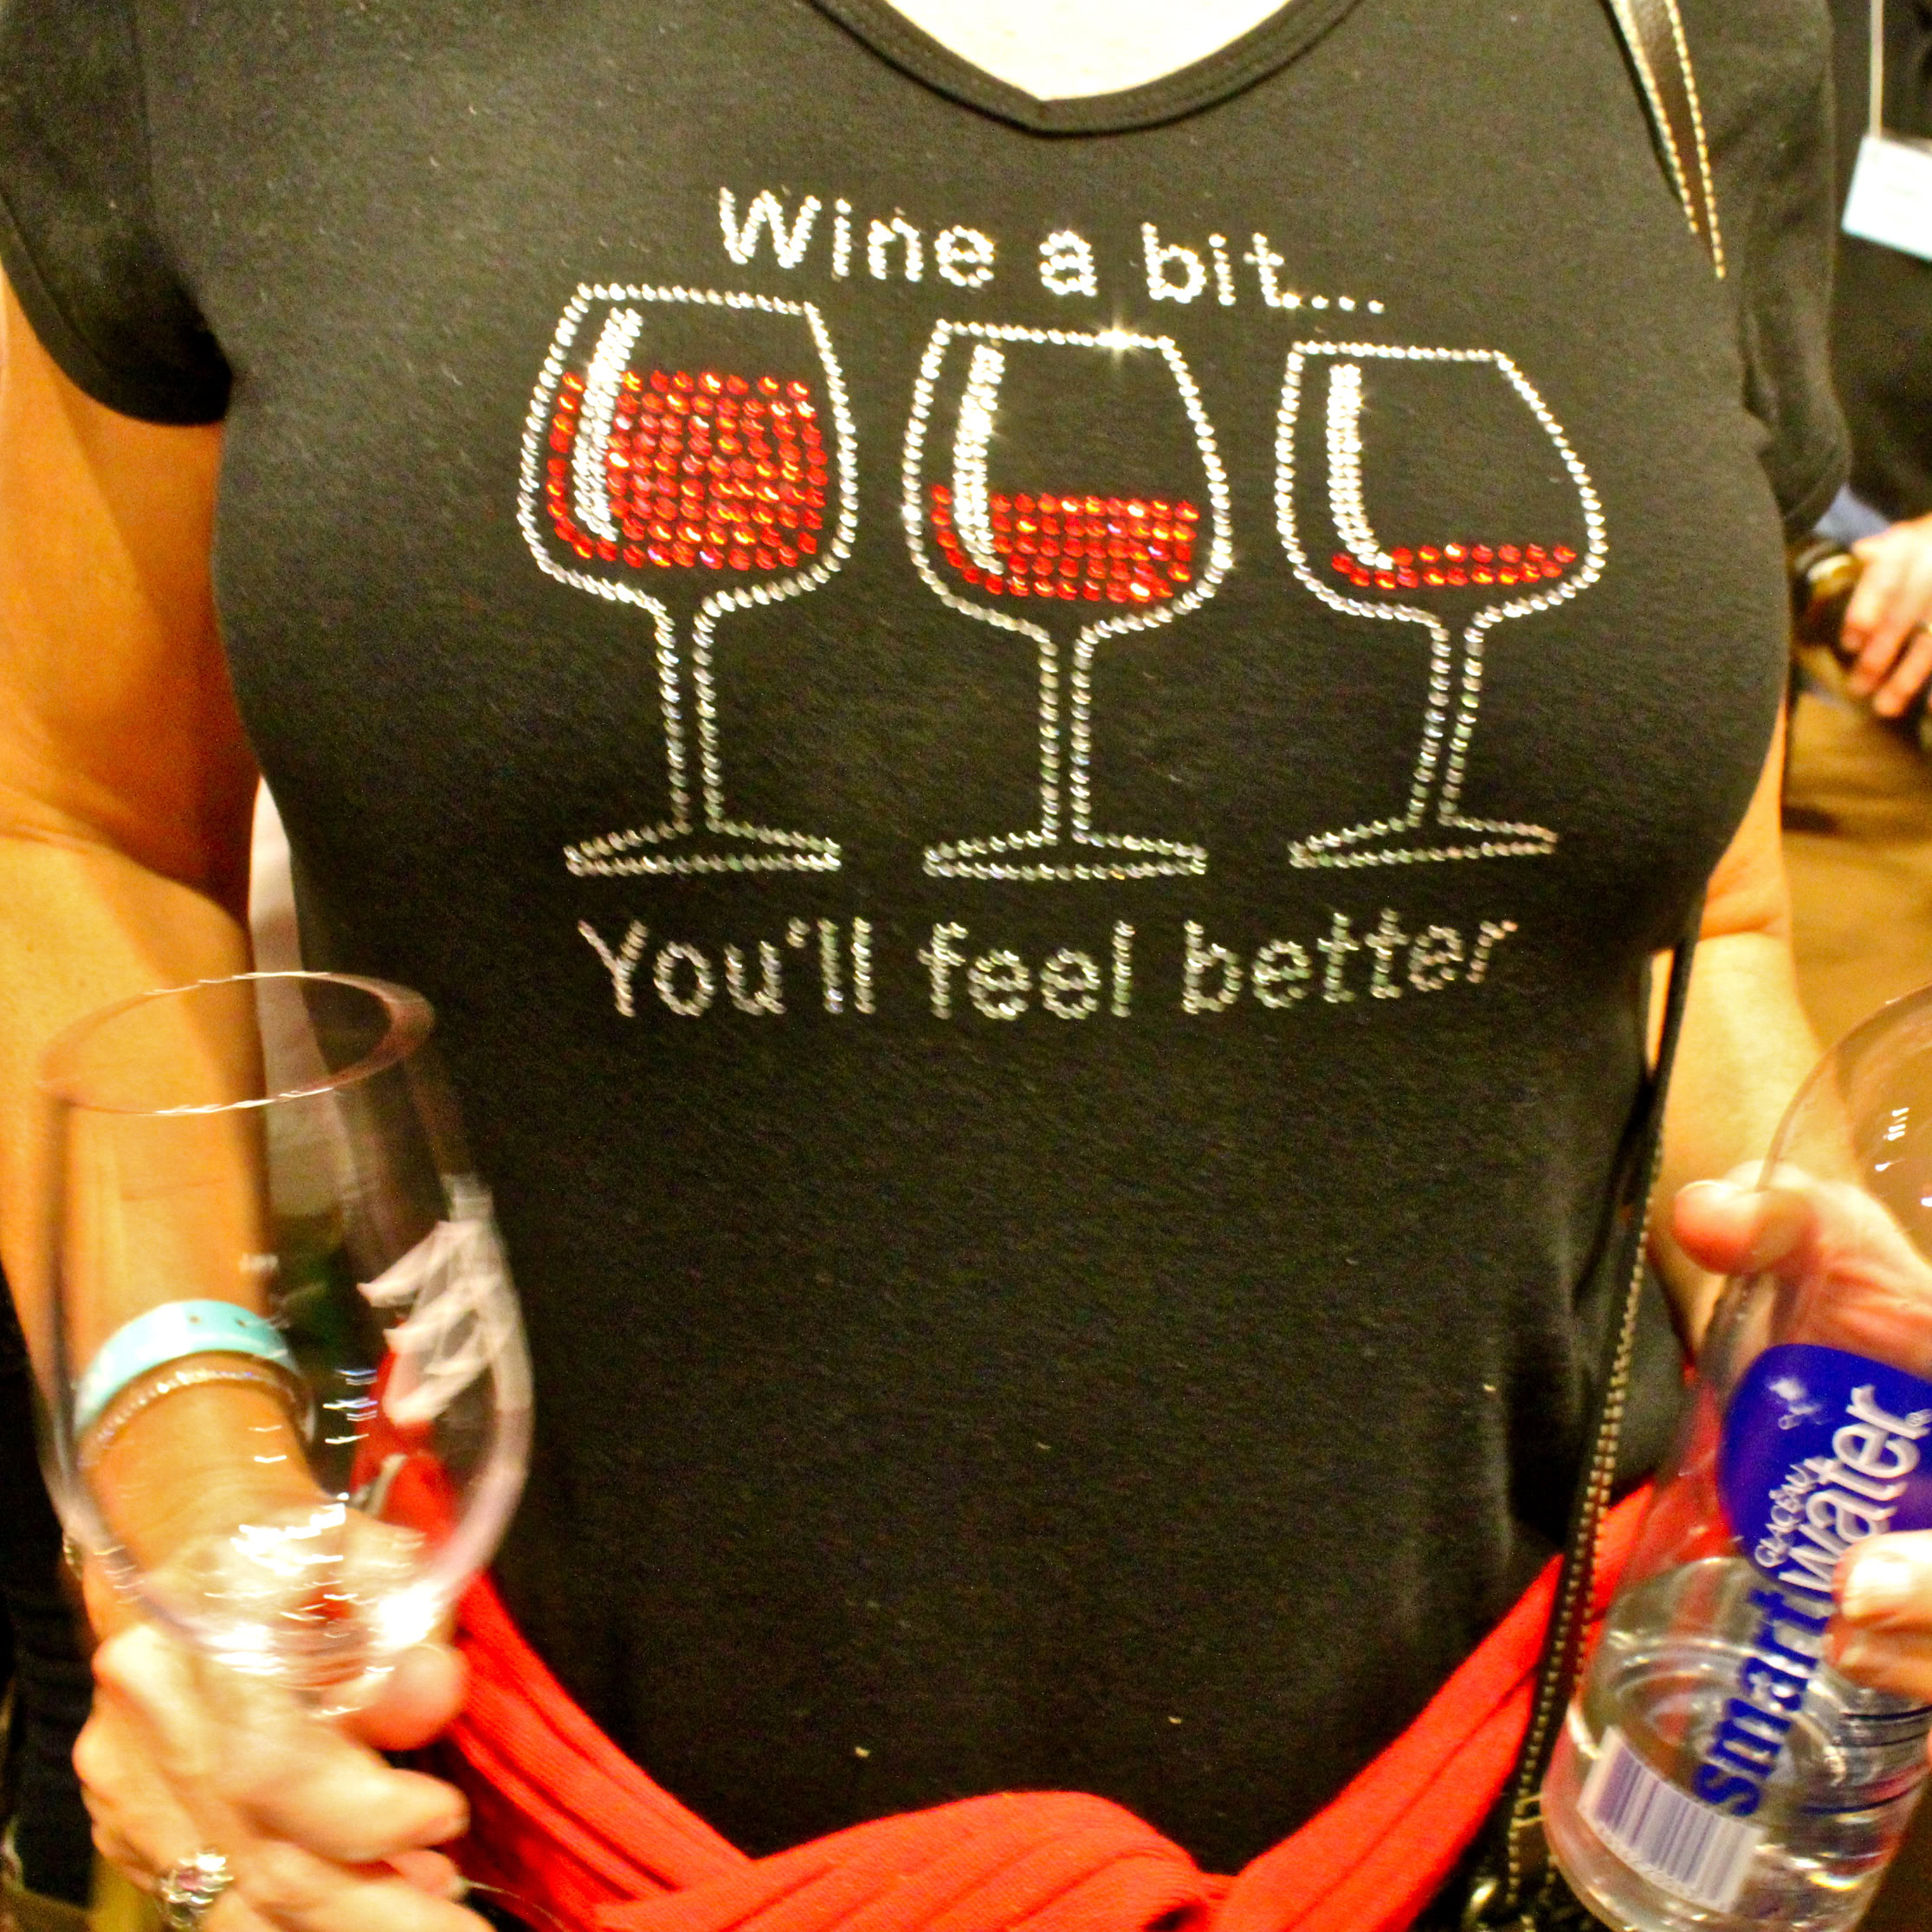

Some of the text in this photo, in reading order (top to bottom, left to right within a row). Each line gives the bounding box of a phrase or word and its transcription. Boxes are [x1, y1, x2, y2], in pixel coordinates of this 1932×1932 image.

[719, 185, 996, 289] Wine
[1038, 229, 1098, 297] a
[577, 908, 1519, 1021] You'll feel better
